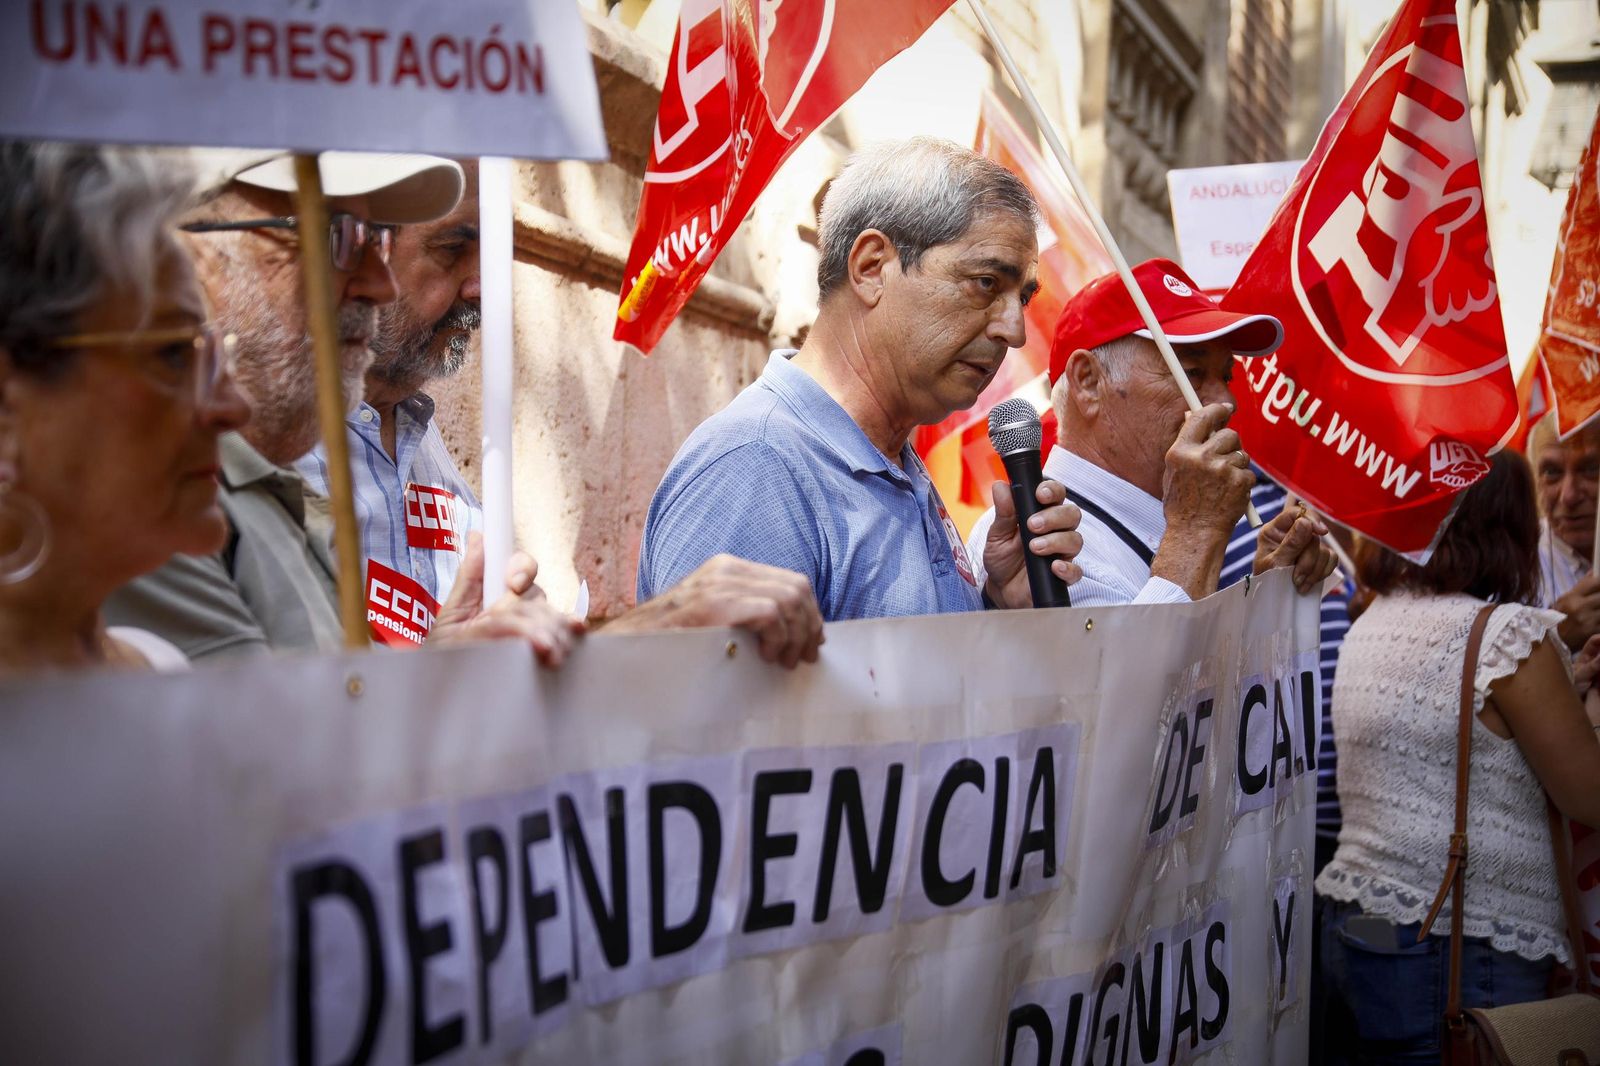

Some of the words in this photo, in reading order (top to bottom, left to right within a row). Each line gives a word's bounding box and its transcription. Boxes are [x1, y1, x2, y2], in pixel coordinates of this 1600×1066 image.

[29, 0, 184, 69] UNA
[203, 14, 546, 95] PRESTACIÓN
[290, 746, 1057, 1066] DEPENDENCIA
[1148, 698, 1214, 834] DE
[1004, 921, 1231, 1066] DIGNAS
[1272, 891, 1296, 1001] Y
